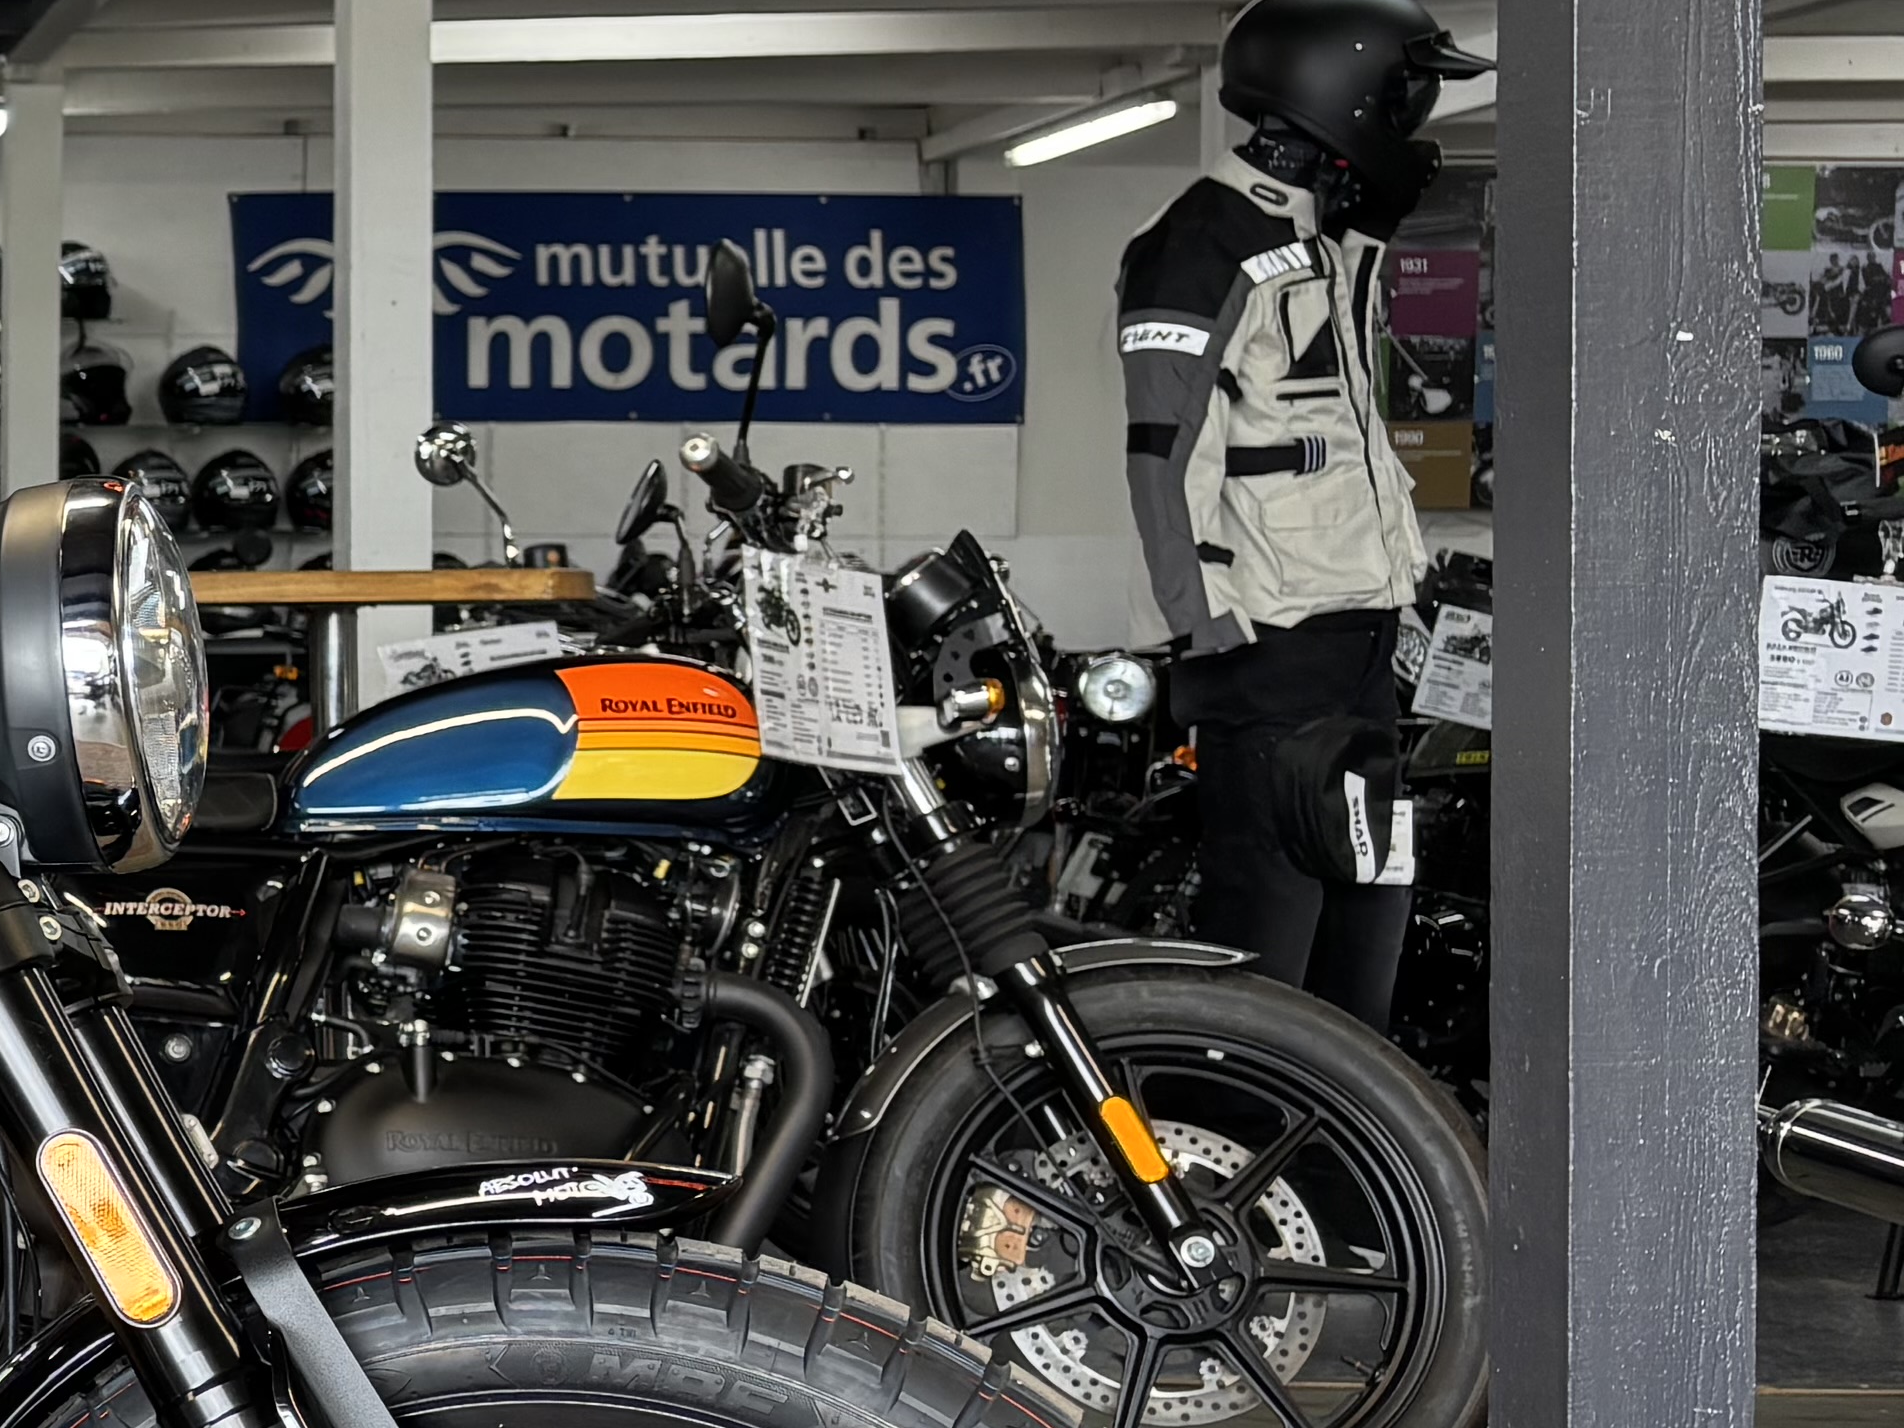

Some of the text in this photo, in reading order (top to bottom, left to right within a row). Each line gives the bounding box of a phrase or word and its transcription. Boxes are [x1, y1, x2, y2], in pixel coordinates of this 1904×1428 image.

[535, 228, 958, 289] mutulle des
[600, 695, 738, 719] ROYAL ENFIELD
[1351, 797, 1371, 859] SHAD
[103, 902, 233, 920] INTERCEPTOR
[385, 1130, 463, 1153] ROYAL
[589, 1352, 790, 1416] MRF
